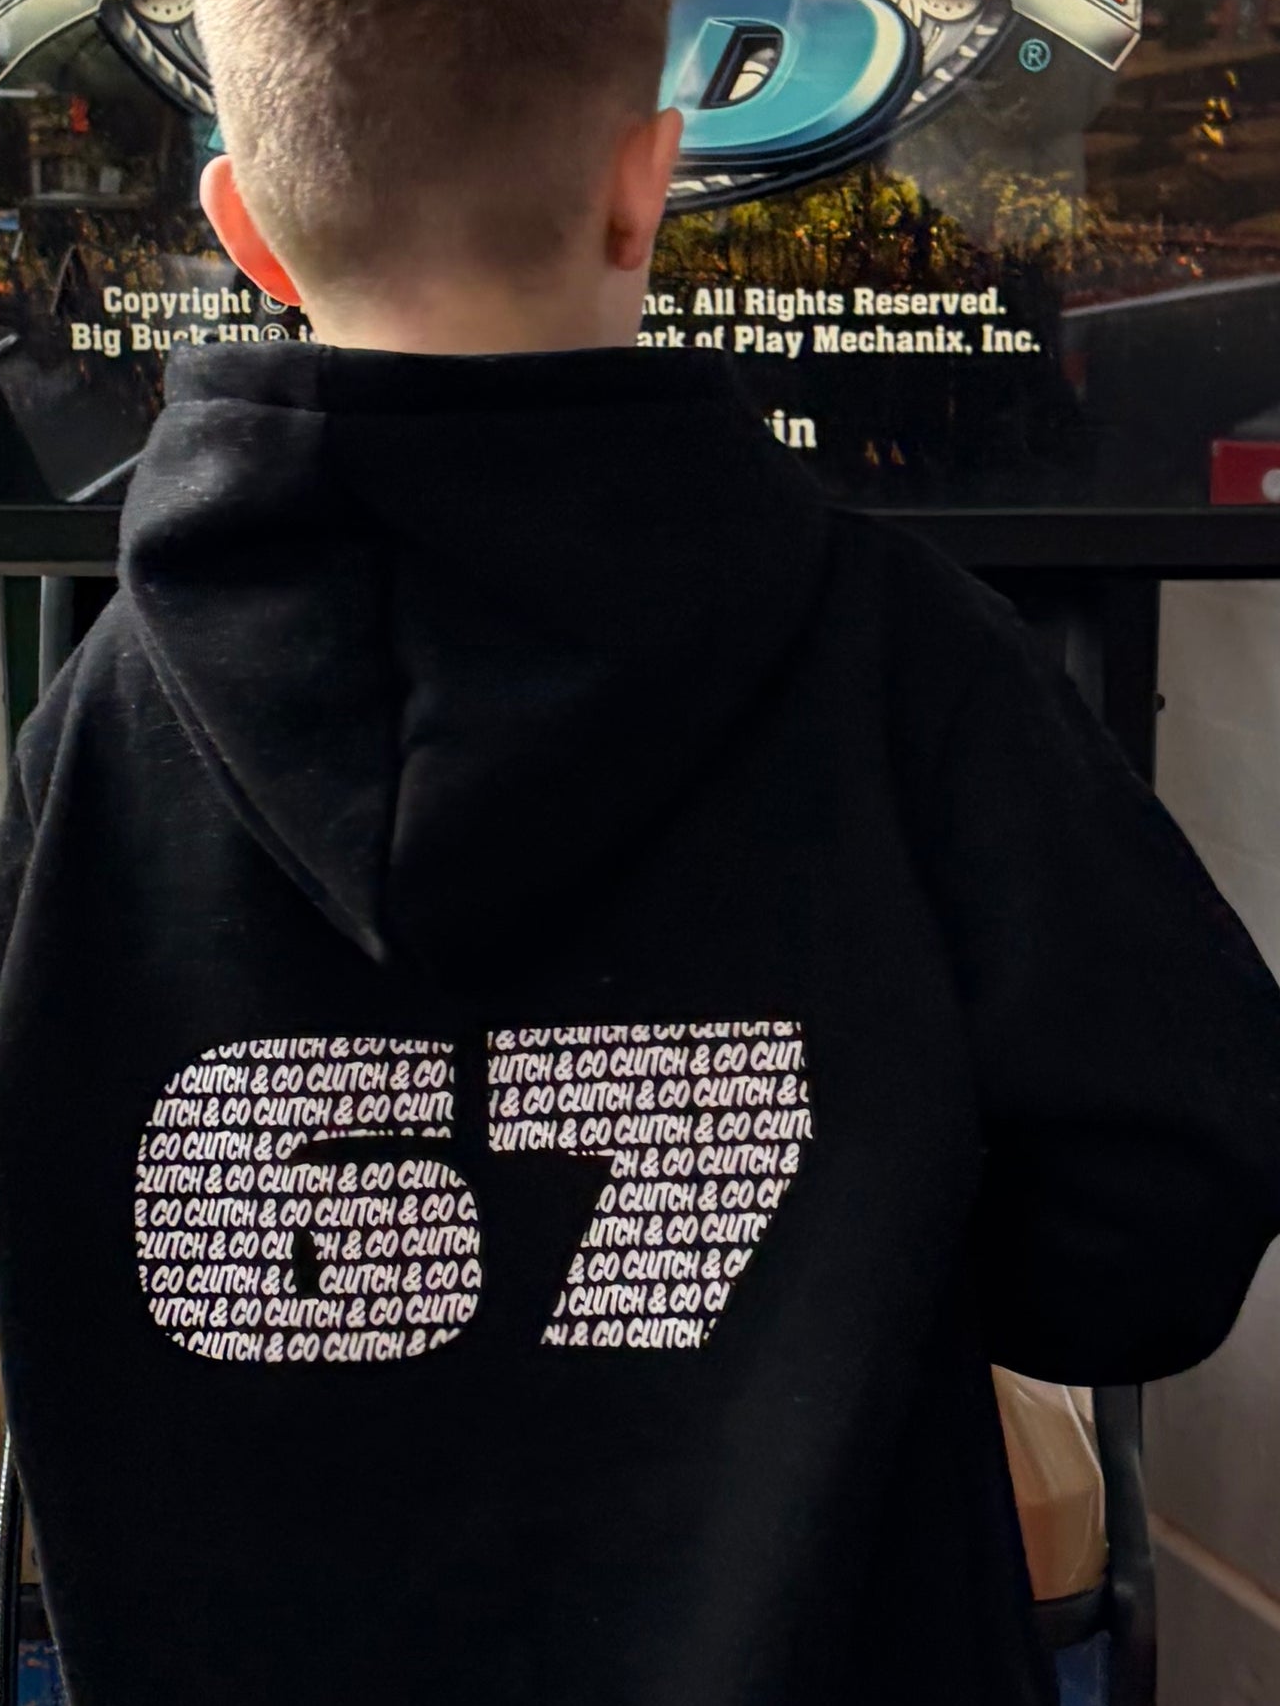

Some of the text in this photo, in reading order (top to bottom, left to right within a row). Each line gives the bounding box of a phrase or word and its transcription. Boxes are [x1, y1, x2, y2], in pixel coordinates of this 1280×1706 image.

[103, 286, 251, 320] Copyright
[692, 288, 735, 315] All
[744, 288, 845, 322] Rights
[853, 287, 1007, 315] Reserved.
[71, 322, 121, 357] Big
[695, 325, 725, 350] of
[734, 325, 804, 359] Play
[813, 324, 973, 355] Mechanix,
[982, 323, 1041, 353] Inc.
[764, 409, 817, 448] in
[182, 1065, 249, 1094] CLUTCH
[250, 1065, 269, 1094] &
[272, 1063, 304, 1093] CO
[306, 1062, 389, 1092] CLUTCH
[390, 1060, 410, 1090] &
[413, 1060, 447, 1088] CO
[488, 1041, 806, 1084] LUTCH & CO CLUTCH & CO CLUT
[146, 1098, 203, 1127] UTCH
[203, 1097, 220, 1127] &
[222, 1098, 251, 1126] CO
[253, 1097, 332, 1126] CLUTCH
[333, 1095, 353, 1125] &
[357, 1094, 390, 1123] CO
[499, 1087, 520, 1118] &
[522, 1085, 555, 1115] CO
[557, 1083, 635, 1113] CLUTCH
[635, 1080, 656, 1110] &
[658, 1079, 691, 1108] CO
[693, 1076, 777, 1107] CLUTCH
[776, 1074, 797, 1106] &
[149, 1133, 181, 1161] CO
[182, 1131, 253, 1161] CLUTCH
[253, 1131, 273, 1161] &
[488, 1120, 557, 1152] LUTCH
[557, 1118, 577, 1149] &
[580, 1117, 612, 1146] CO
[614, 1114, 693, 1145] CLUTCH
[694, 1112, 714, 1143] &
[717, 1111, 751, 1141] CO
[204, 1164, 222, 1193] &
[225, 1165, 255, 1192] CO
[257, 1164, 336, 1193] CLUTCH
[337, 1162, 357, 1192] &
[361, 1162, 395, 1190] CO
[640, 1143, 800, 1178] & CO CLUTCH &
[150, 1199, 182, 1227] CO
[184, 1198, 258, 1227] CLUTCH
[258, 1199, 277, 1228] &
[280, 1199, 312, 1227] CO
[315, 1197, 397, 1226] CLUTCH
[397, 1195, 418, 1224] &
[421, 1194, 455, 1222] CO
[619, 1182, 697, 1212] CLUTCH
[698, 1180, 718, 1211] &
[721, 1180, 754, 1209] CO
[208, 1231, 226, 1259] &
[229, 1231, 259, 1259] CO
[341, 1230, 362, 1260] &
[365, 1229, 399, 1258] CO
[401, 1227, 480, 1257] CLUTCH
[643, 1215, 663, 1245] &
[666, 1215, 698, 1244] CO
[151, 1265, 184, 1293] CO
[186, 1264, 261, 1294] CLUTCH
[261, 1265, 280, 1295] &
[319, 1264, 401, 1295] CLUTCH
[402, 1262, 422, 1292] &
[425, 1260, 459, 1290] CO
[588, 1252, 620, 1282] CO
[622, 1250, 700, 1280] CLUTCH
[701, 1248, 721, 1279] &
[148, 1296, 403, 1328] UTCH & CO CLUTCH & CO
[570, 1286, 647, 1316] CLUTCH
[648, 1283, 667, 1314] &
[670, 1282, 701, 1313] CO
[264, 1332, 284, 1362] &
[287, 1332, 320, 1362] CO
[323, 1331, 405, 1362] CLUTCH
[592, 1320, 624, 1347] CO
[626, 1318, 704, 1348] CLUTCH
